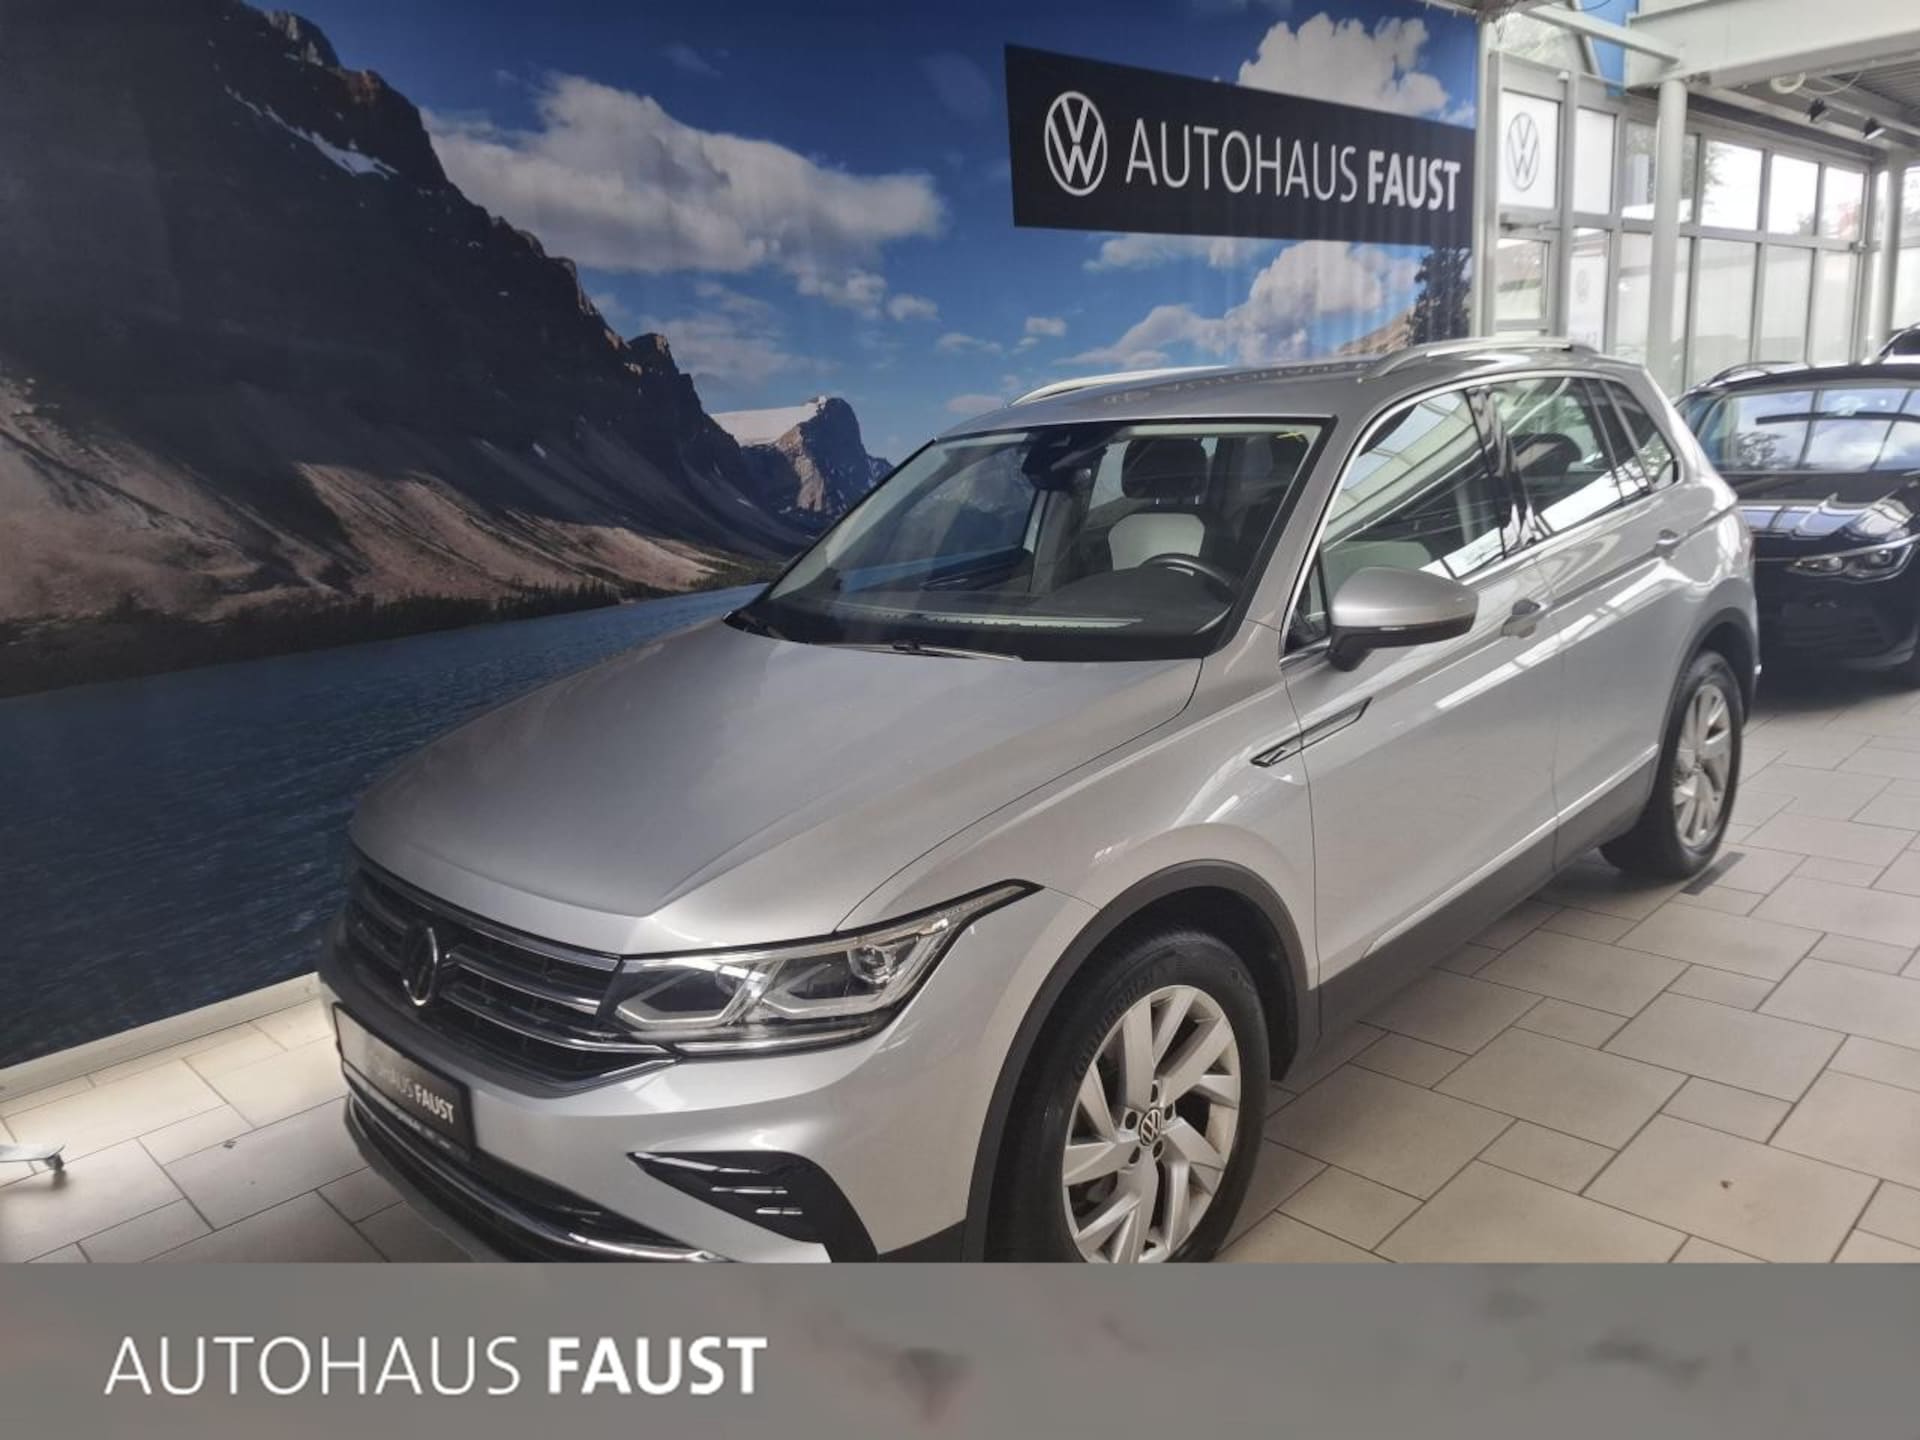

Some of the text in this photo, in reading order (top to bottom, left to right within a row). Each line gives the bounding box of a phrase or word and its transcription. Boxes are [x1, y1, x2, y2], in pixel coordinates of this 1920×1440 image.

[1126, 118, 1461, 212] AUTOHAUS FAUST
[414, 1083, 454, 1124] FAUST
